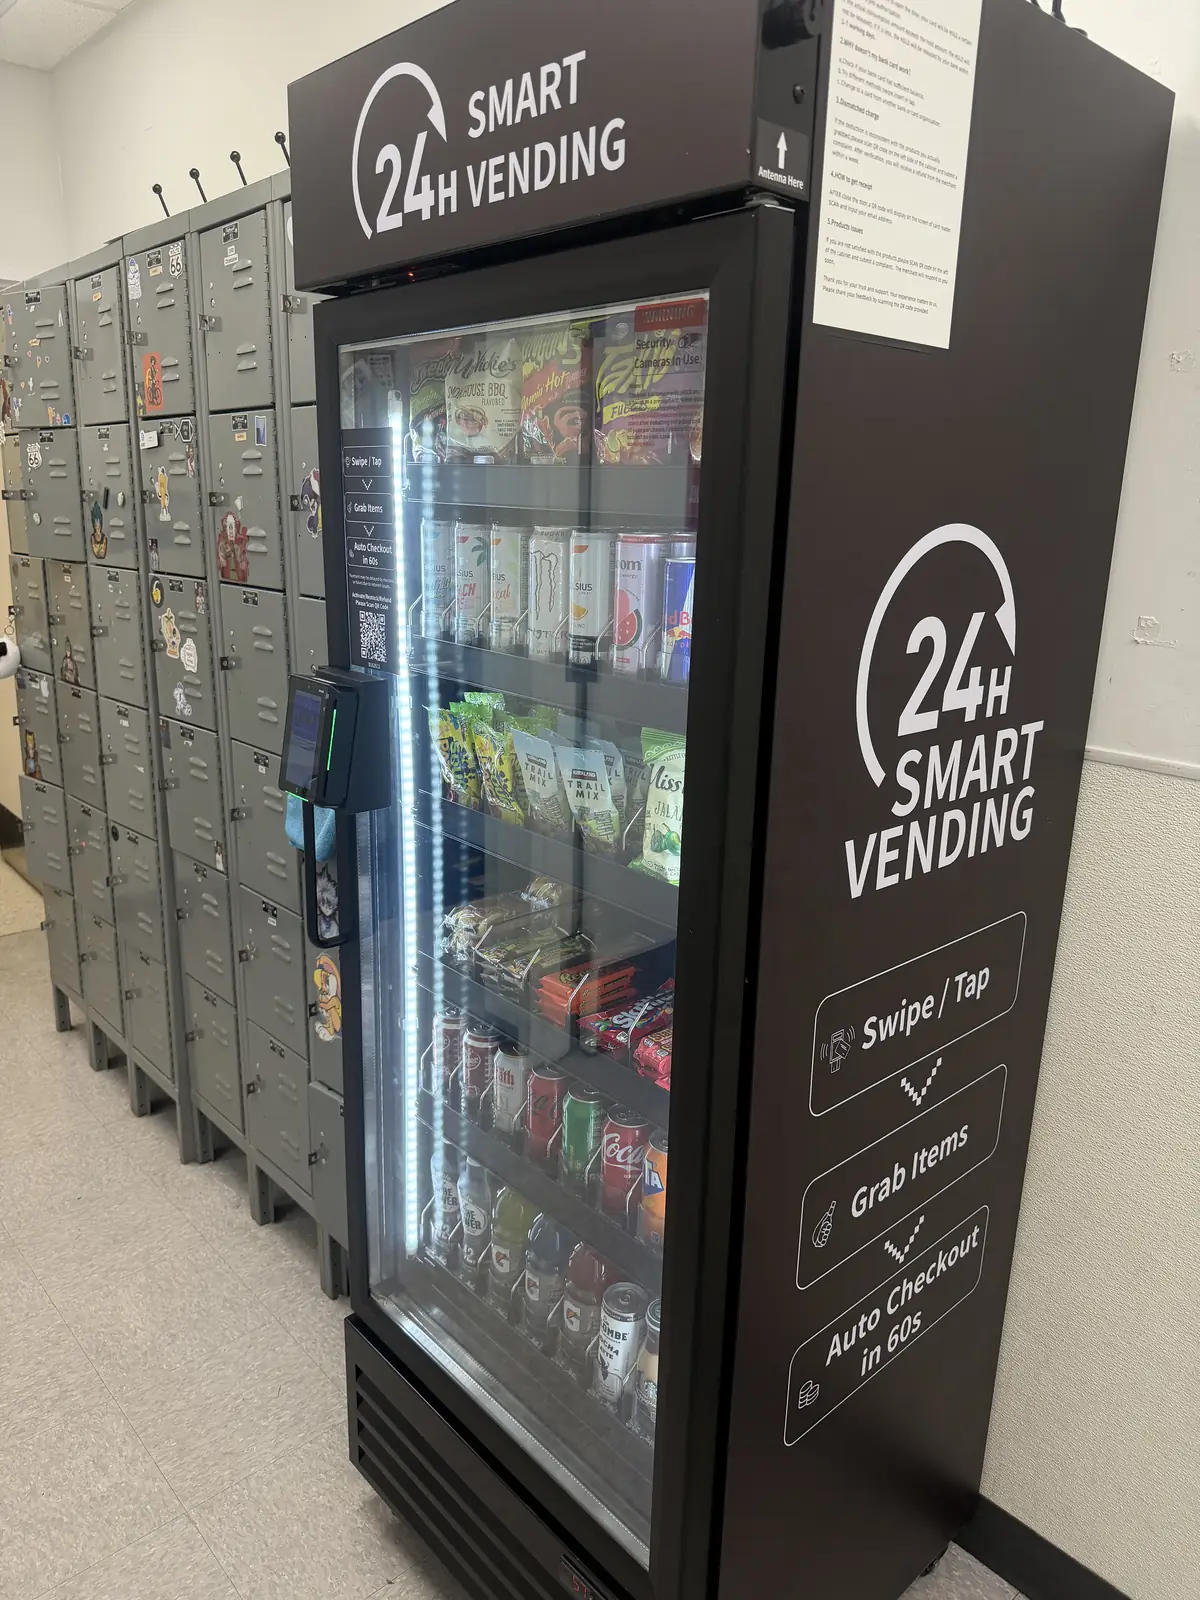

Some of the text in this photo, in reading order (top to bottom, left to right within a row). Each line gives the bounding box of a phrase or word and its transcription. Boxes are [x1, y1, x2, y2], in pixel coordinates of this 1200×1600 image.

[468, 50, 586, 139] SMART
[374, 117, 626, 233] 24H VENDING
[758, 166, 804, 190] Antenna Here
[170, 257, 181, 274] 66
[636, 338, 670, 350] Security
[634, 354, 700, 368] Cameras In Use
[545, 370, 570, 393] Hot
[488, 382, 508, 400] BBQ
[482, 398, 506, 406] FLAVORED
[29, 453, 39, 465] 66
[352, 456, 368, 468] Swipe
[372, 456, 382, 468] Tap
[354, 503, 383, 513] Grab Items
[354, 542, 392, 554] Auto Checkout
[362, 555, 378, 566] in 60s
[574, 582, 593, 592] SIUS
[898, 612, 1012, 736] 24H
[525, 763, 554, 780] TRAIL
[891, 720, 1044, 817] SMART
[530, 774, 546, 787] MIX
[568, 780, 606, 792] TRAIL
[576, 790, 600, 800] MIX
[845, 785, 1035, 899] VENDING
[862, 966, 990, 1050] Swipe / Tap
[602, 1133, 644, 1164] Coca
[851, 1124, 969, 1219] Grab Items
[826, 1224, 980, 1365] Auto Checkout
[602, 1324, 628, 1341] OMBE
[860, 1309, 922, 1377] in 60s
